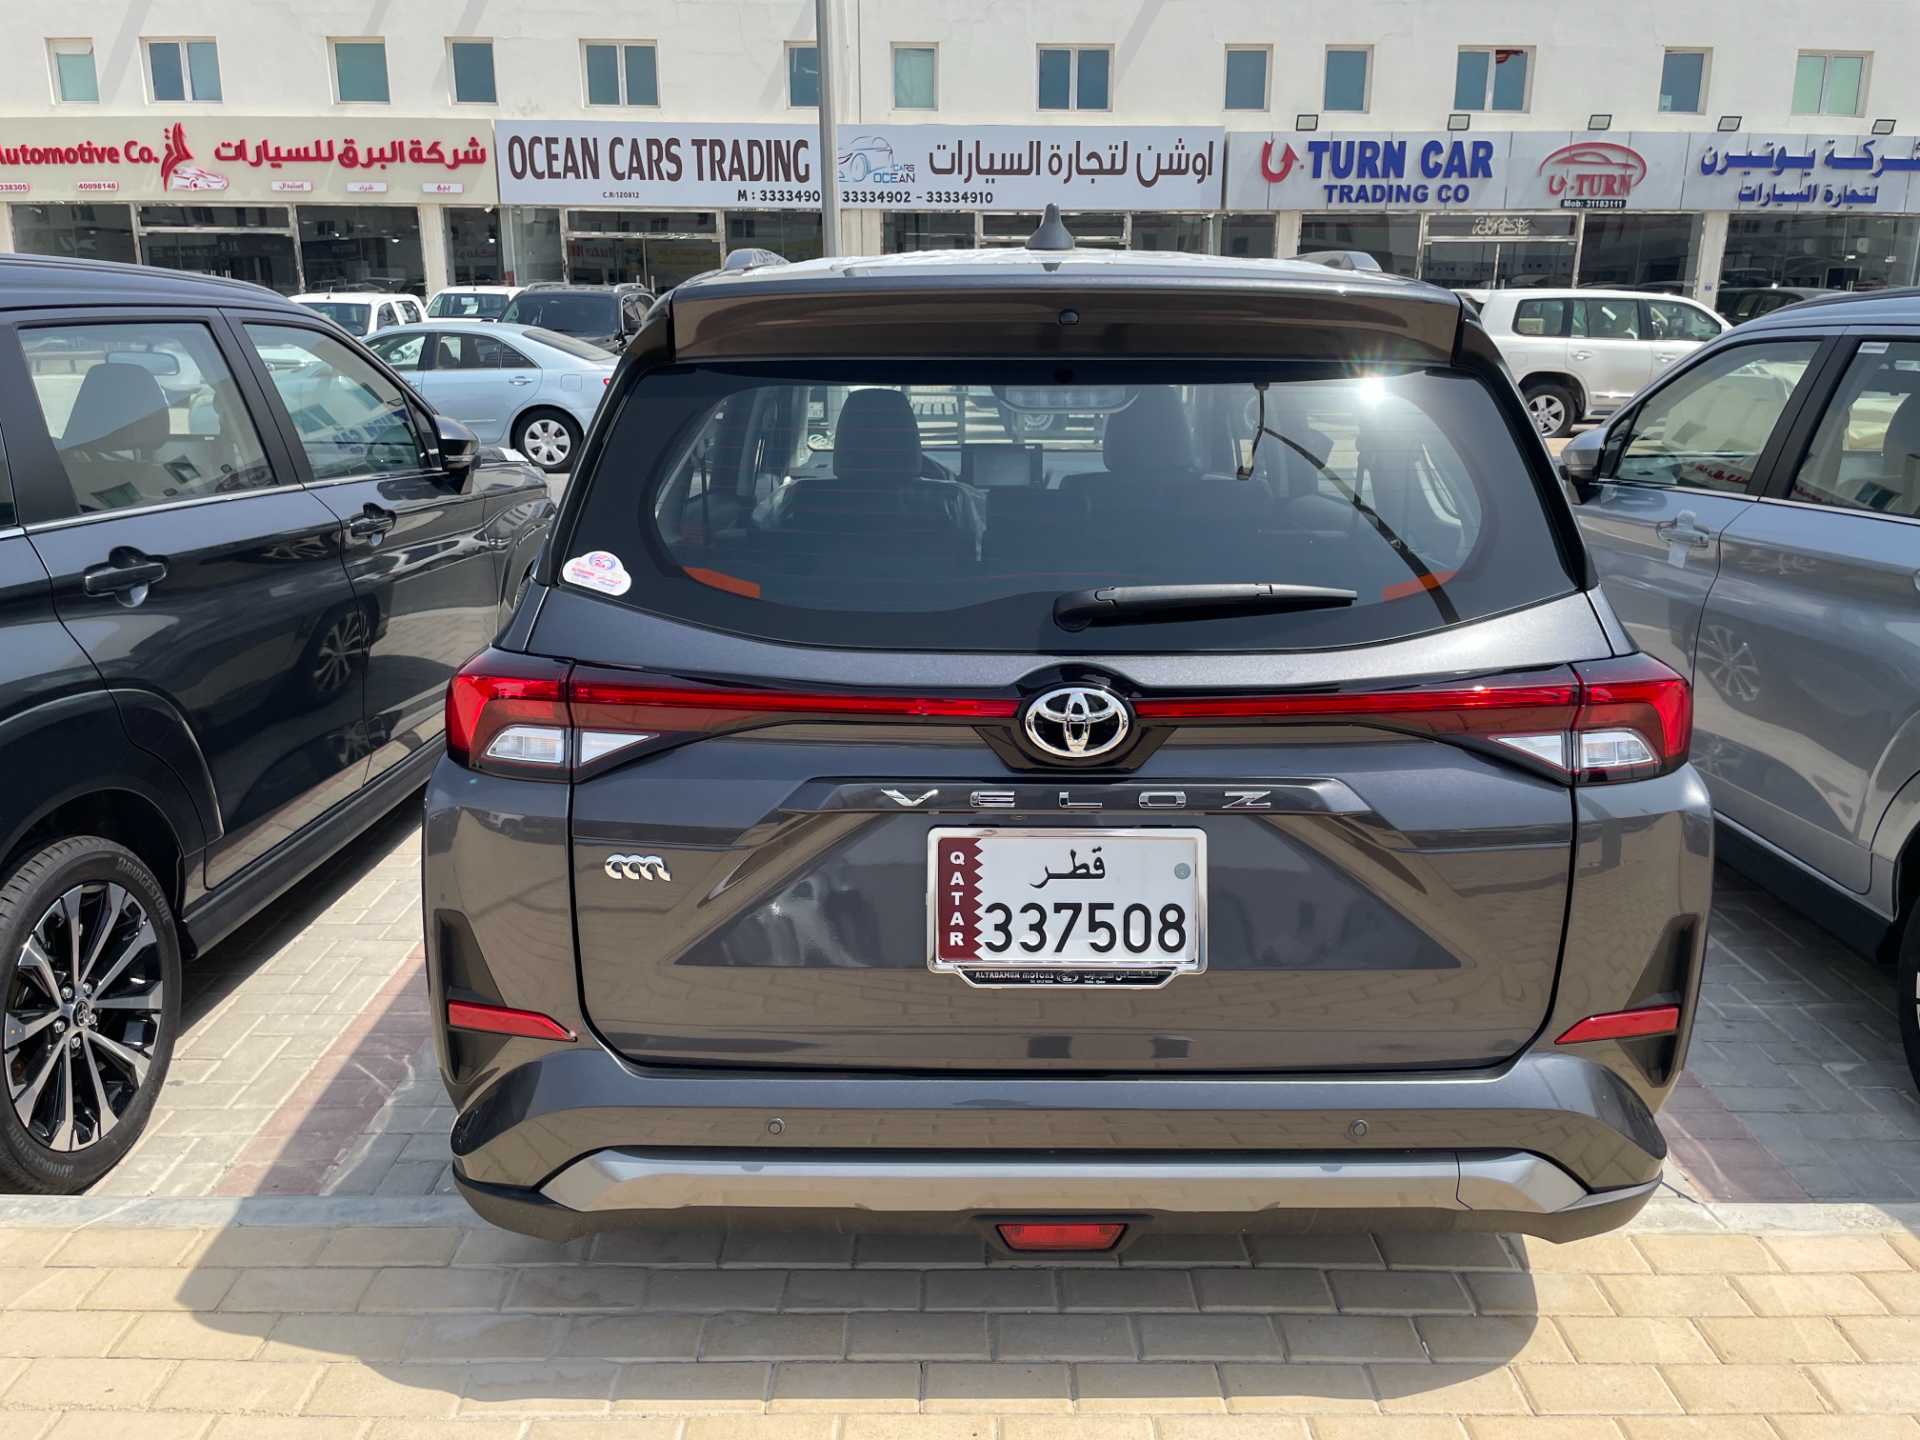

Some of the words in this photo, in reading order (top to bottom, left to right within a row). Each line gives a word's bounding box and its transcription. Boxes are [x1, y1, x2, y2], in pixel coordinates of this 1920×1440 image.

[124, 141, 160, 164] Co.
[215, 139, 335, 168] للسيارات
[338, 139, 406, 169] البرق
[409, 137, 487, 169] شركة
[508, 135, 600, 180] OCEAN
[609, 137, 683, 182] CARS
[691, 138, 810, 183] TRADING
[929, 139, 1041, 184] السيارات
[1048, 140, 1128, 184] لتجارة
[1136, 138, 1214, 188] اوشن
[1420, 140, 1494, 179] CAR
[1824, 139, 1920, 178] ركة
[873, 173, 915, 184] OCEAN
[1324, 184, 1429, 203] TRADING
[1437, 184, 1470, 203] CO
[1738, 182, 1818, 207] السيارات
[760, 190, 821, 201] 3333490
[842, 191, 911, 203] 33334902
[926, 191, 993, 204] 33334910
[881, 788, 1272, 809] VELOZ
[1029, 846, 1106, 889] قطر
[949, 851, 965, 946] QATAR
[984, 902, 1187, 953] 337508
